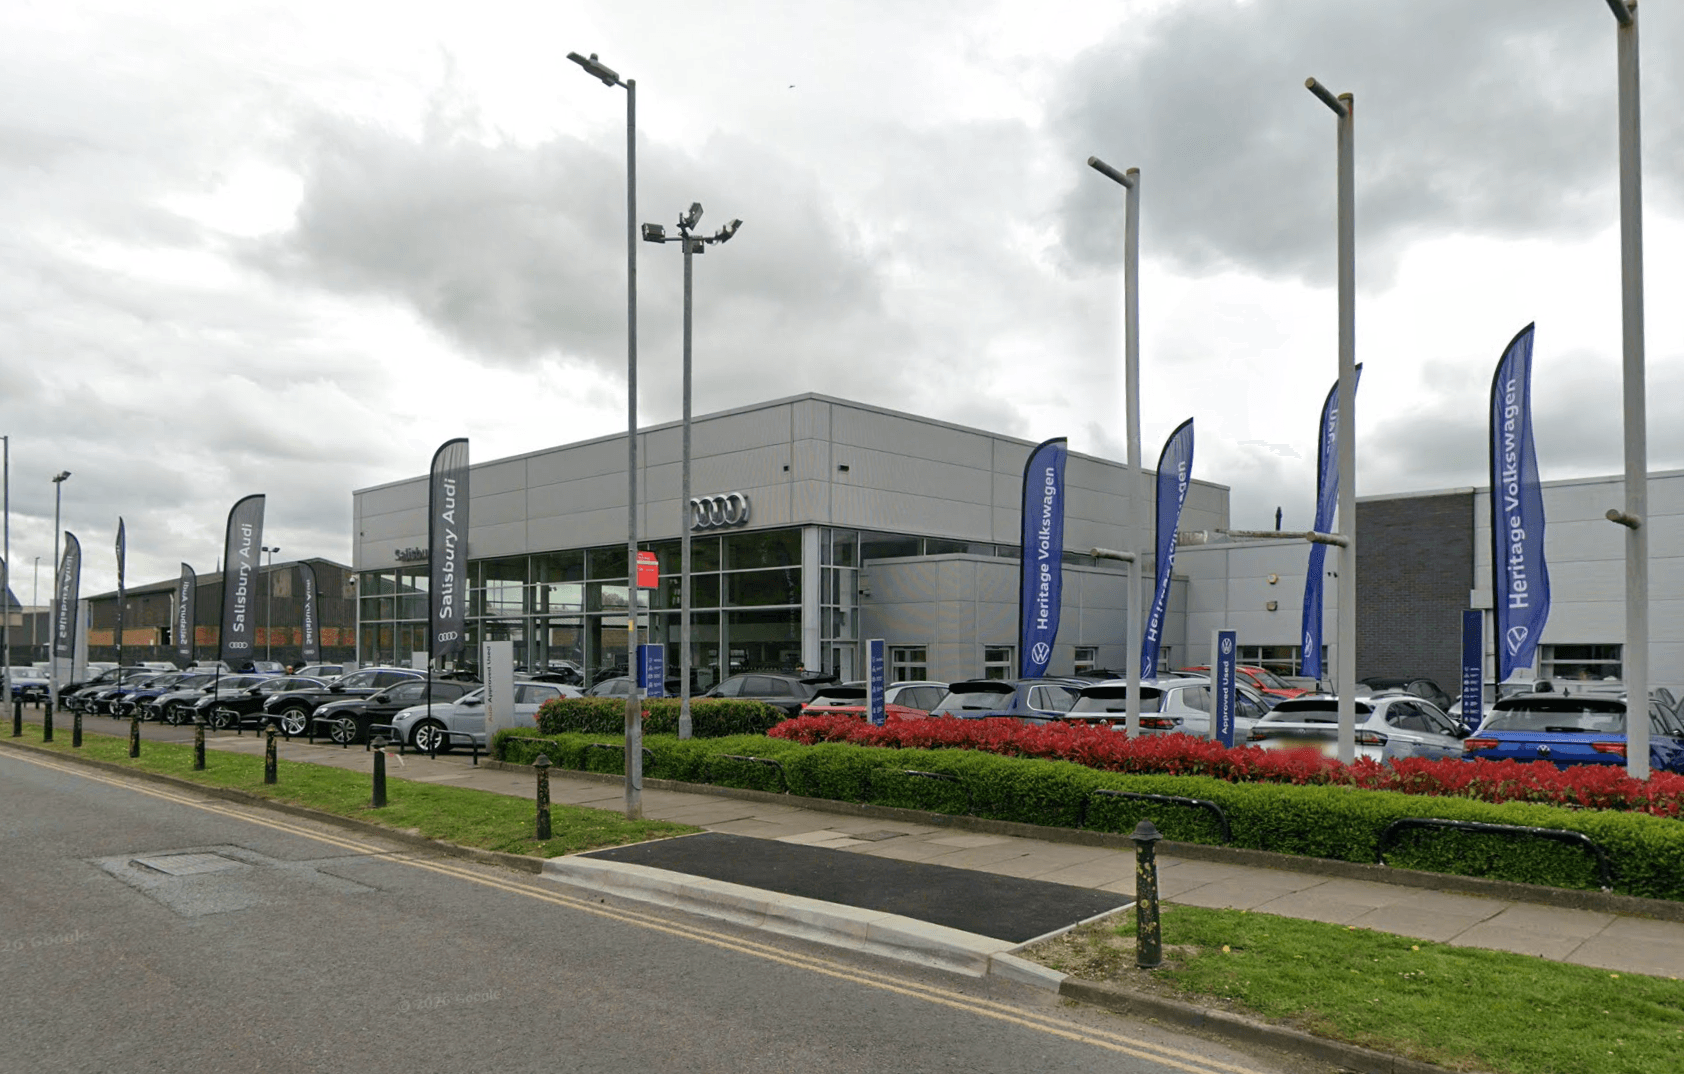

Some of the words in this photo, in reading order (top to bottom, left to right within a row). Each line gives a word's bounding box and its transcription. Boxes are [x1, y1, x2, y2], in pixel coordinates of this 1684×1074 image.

[1502, 379, 1520, 511] Volkswagen
[442, 478, 456, 524] Audi
[1038, 467, 1056, 560] Volkswagen
[239, 523, 253, 558] Audi
[394, 546, 428, 562] Salisbu
[440, 528, 458, 619] Salisbury
[1508, 516, 1529, 608] Heritage
[233, 561, 251, 633] Salisbury
[1036, 563, 1051, 630] Heritage
[1221, 687, 1230, 735] Approved
